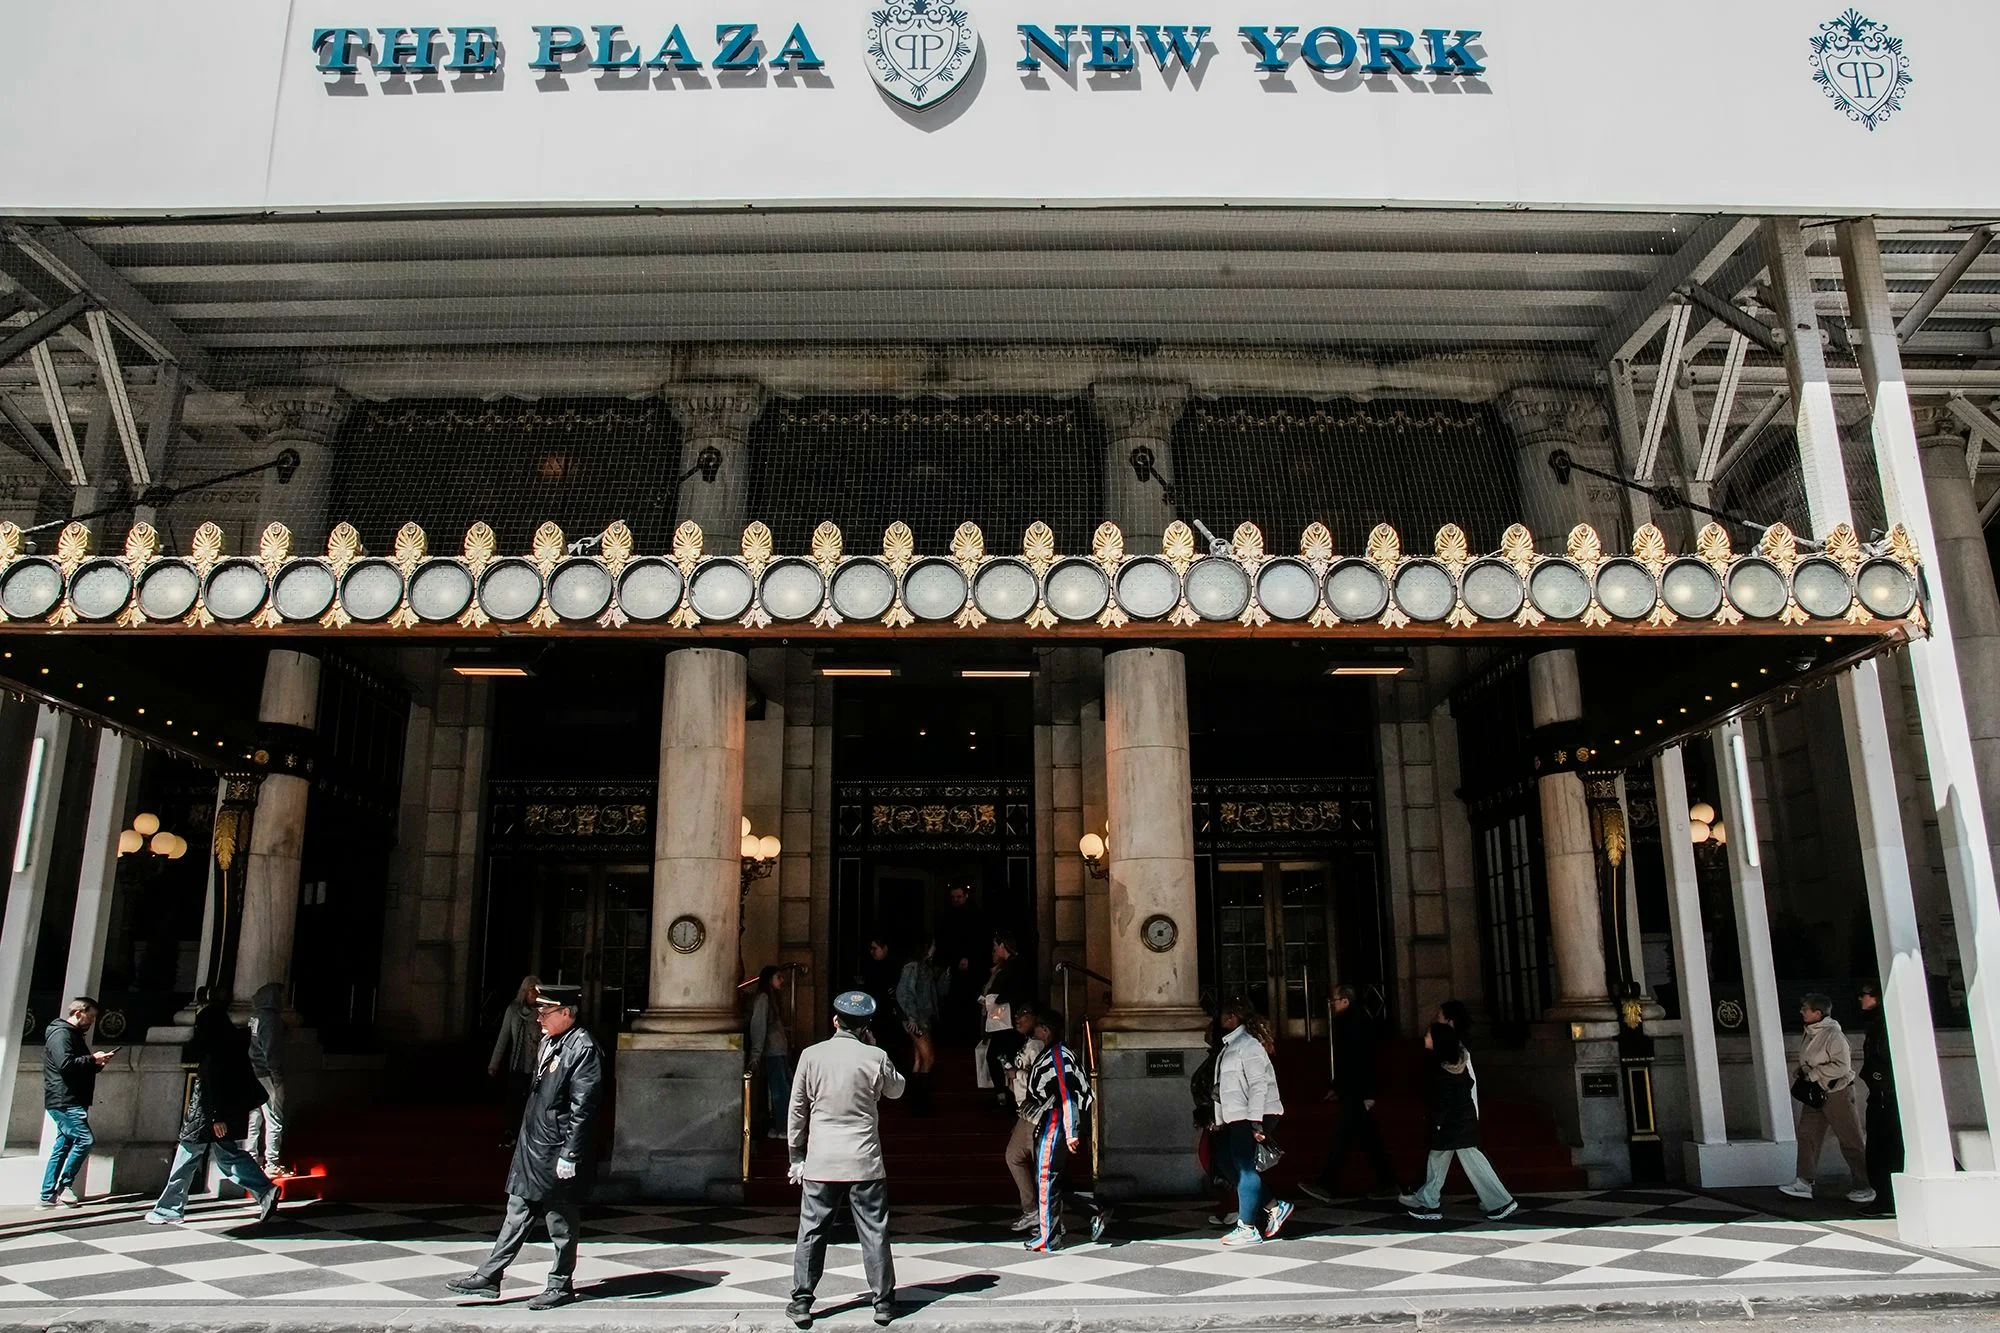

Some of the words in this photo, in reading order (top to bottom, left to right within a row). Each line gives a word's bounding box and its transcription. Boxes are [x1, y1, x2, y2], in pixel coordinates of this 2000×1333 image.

[311, 25, 498, 73] THE
[528, 21, 825, 71] PLAZA
[1016, 24, 1212, 72] NEW
[1238, 25, 1487, 76] YORK
